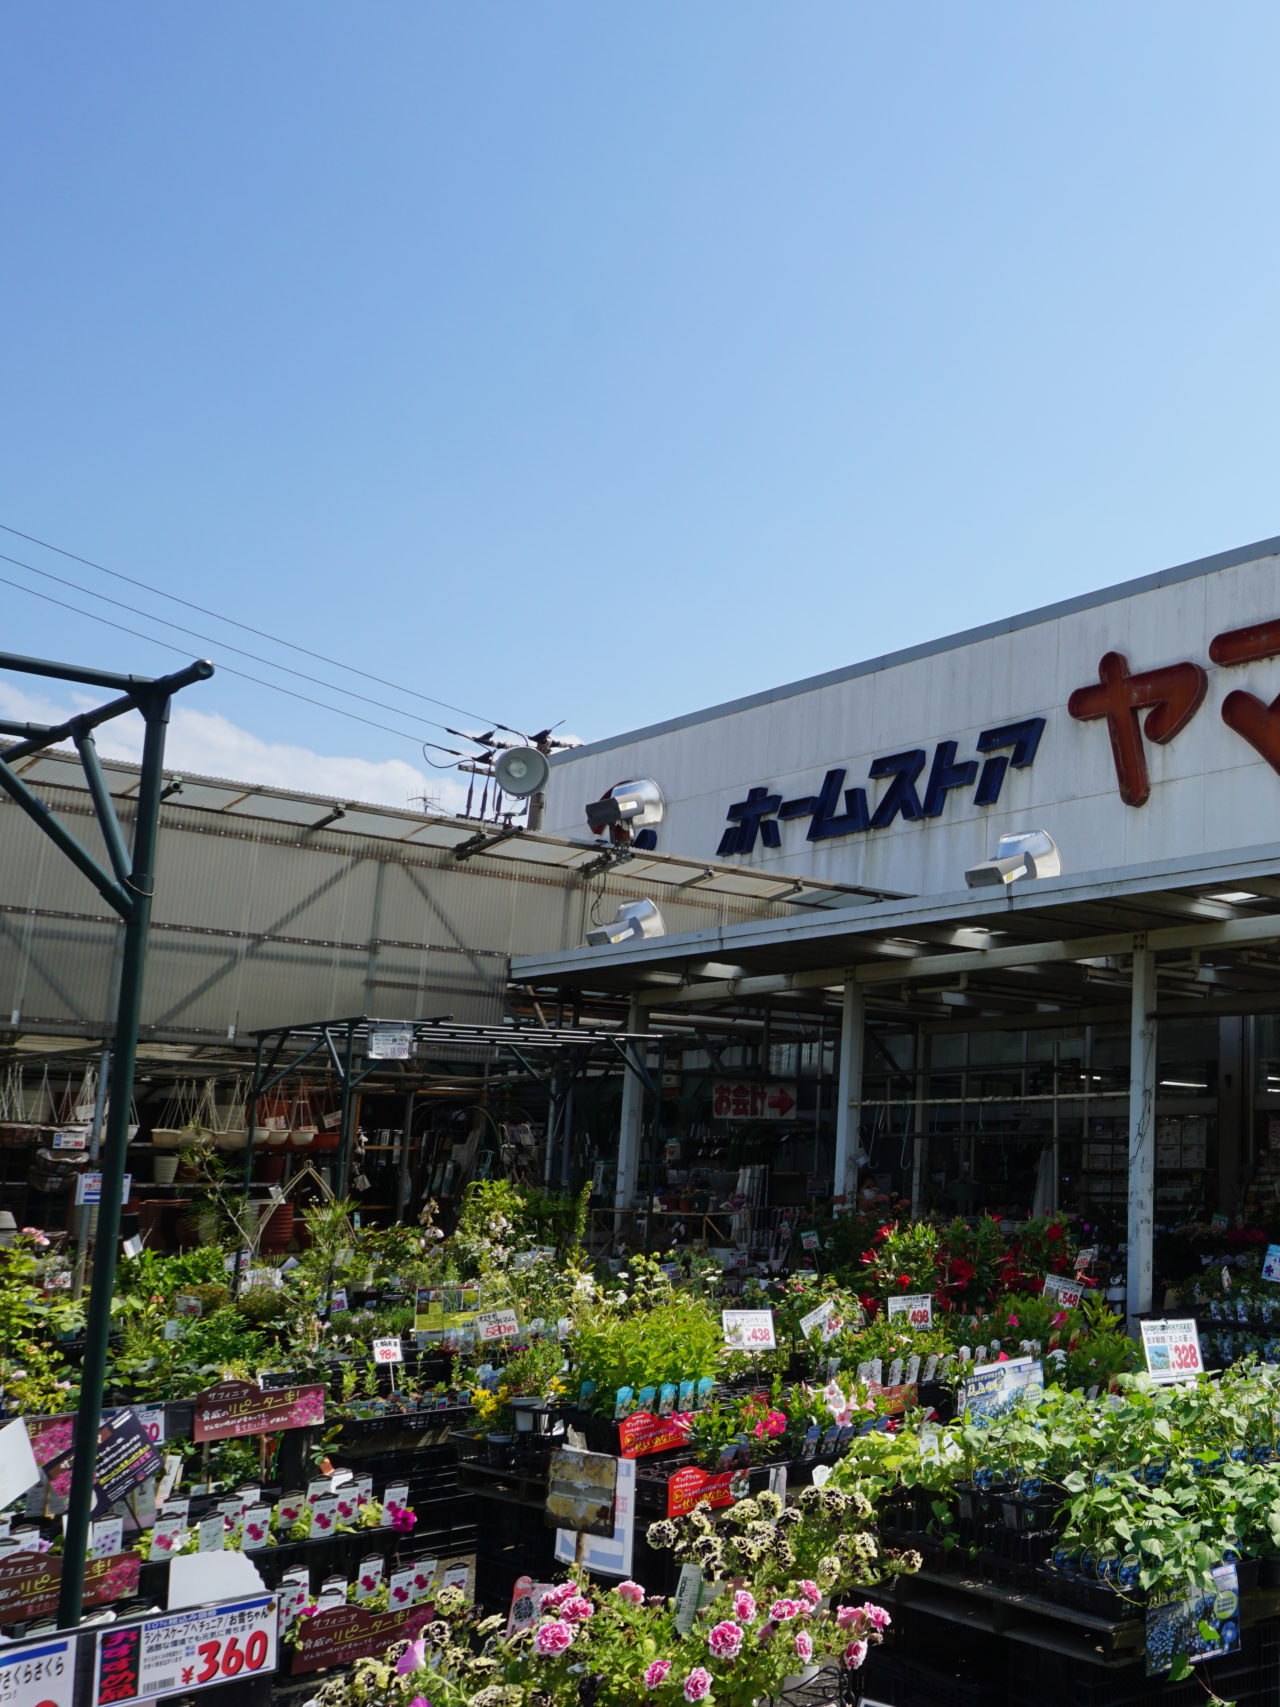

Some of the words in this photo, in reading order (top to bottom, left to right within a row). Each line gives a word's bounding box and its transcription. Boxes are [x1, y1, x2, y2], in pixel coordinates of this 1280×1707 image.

[715, 717, 1047, 857] ホームストア
[714, 1085, 767, 1116] お会計
[485, 1324, 517, 1337] 580円
[208, 1388, 250, 1399] サフィニア
[0, 1561, 48, 1577] フィニア
[312, 1613, 358, 1627] サフィニア
[0, 1656, 65, 1691] さくらさくら
